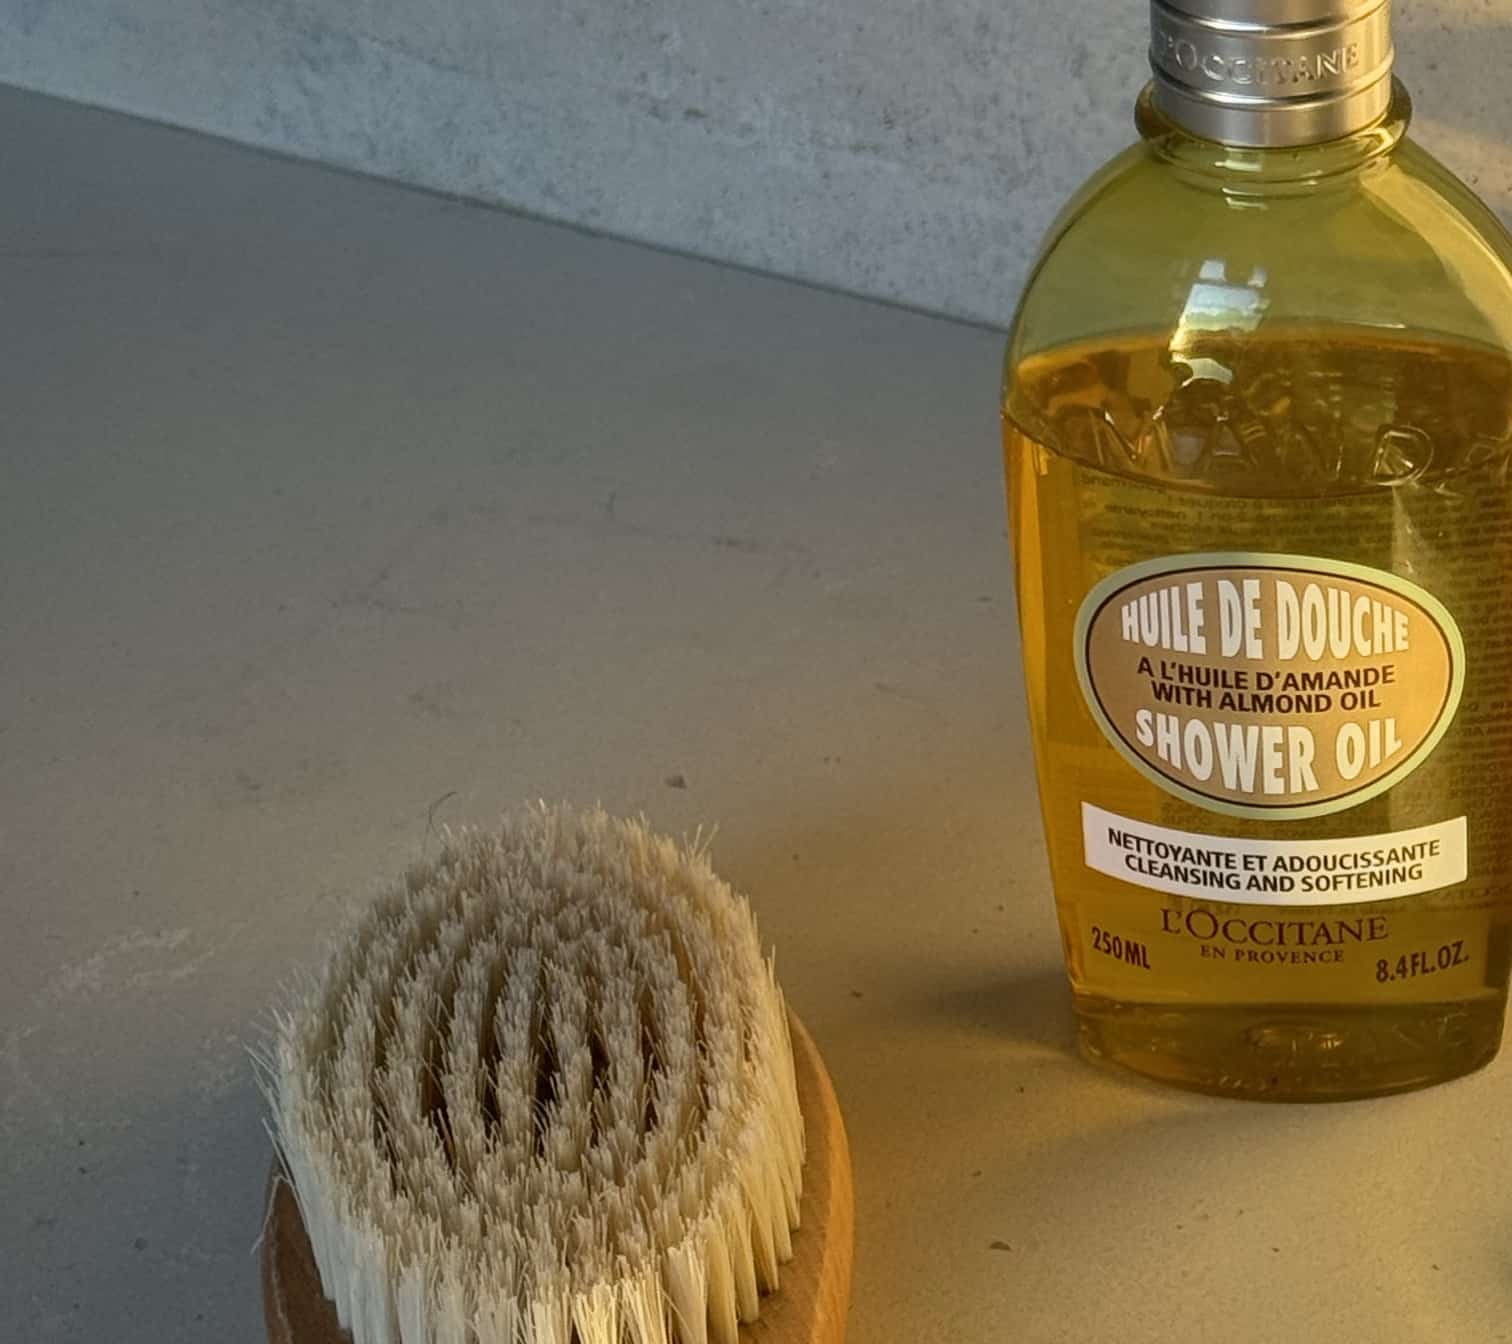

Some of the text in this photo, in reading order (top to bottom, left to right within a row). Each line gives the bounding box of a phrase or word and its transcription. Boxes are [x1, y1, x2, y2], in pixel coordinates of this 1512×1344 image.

[1121, 579, 1409, 660] HUILE DE DOUCHE
[1137, 657, 1396, 691] A L'HUILE D'AMANDE
[1152, 681, 1381, 713] WITH ALMOND OIL
[1136, 709, 1402, 795] SHOWER OIL
[1108, 827, 1441, 873] NETTOYANTE ET ADOUCISSANTE
[1125, 854, 1423, 892] CLEANSING AND SOFTENING
[1161, 908, 1389, 946] L'OCCITANE
[1091, 927, 1151, 970] 250ML
[1201, 944, 1344, 964] EN PROVENCE
